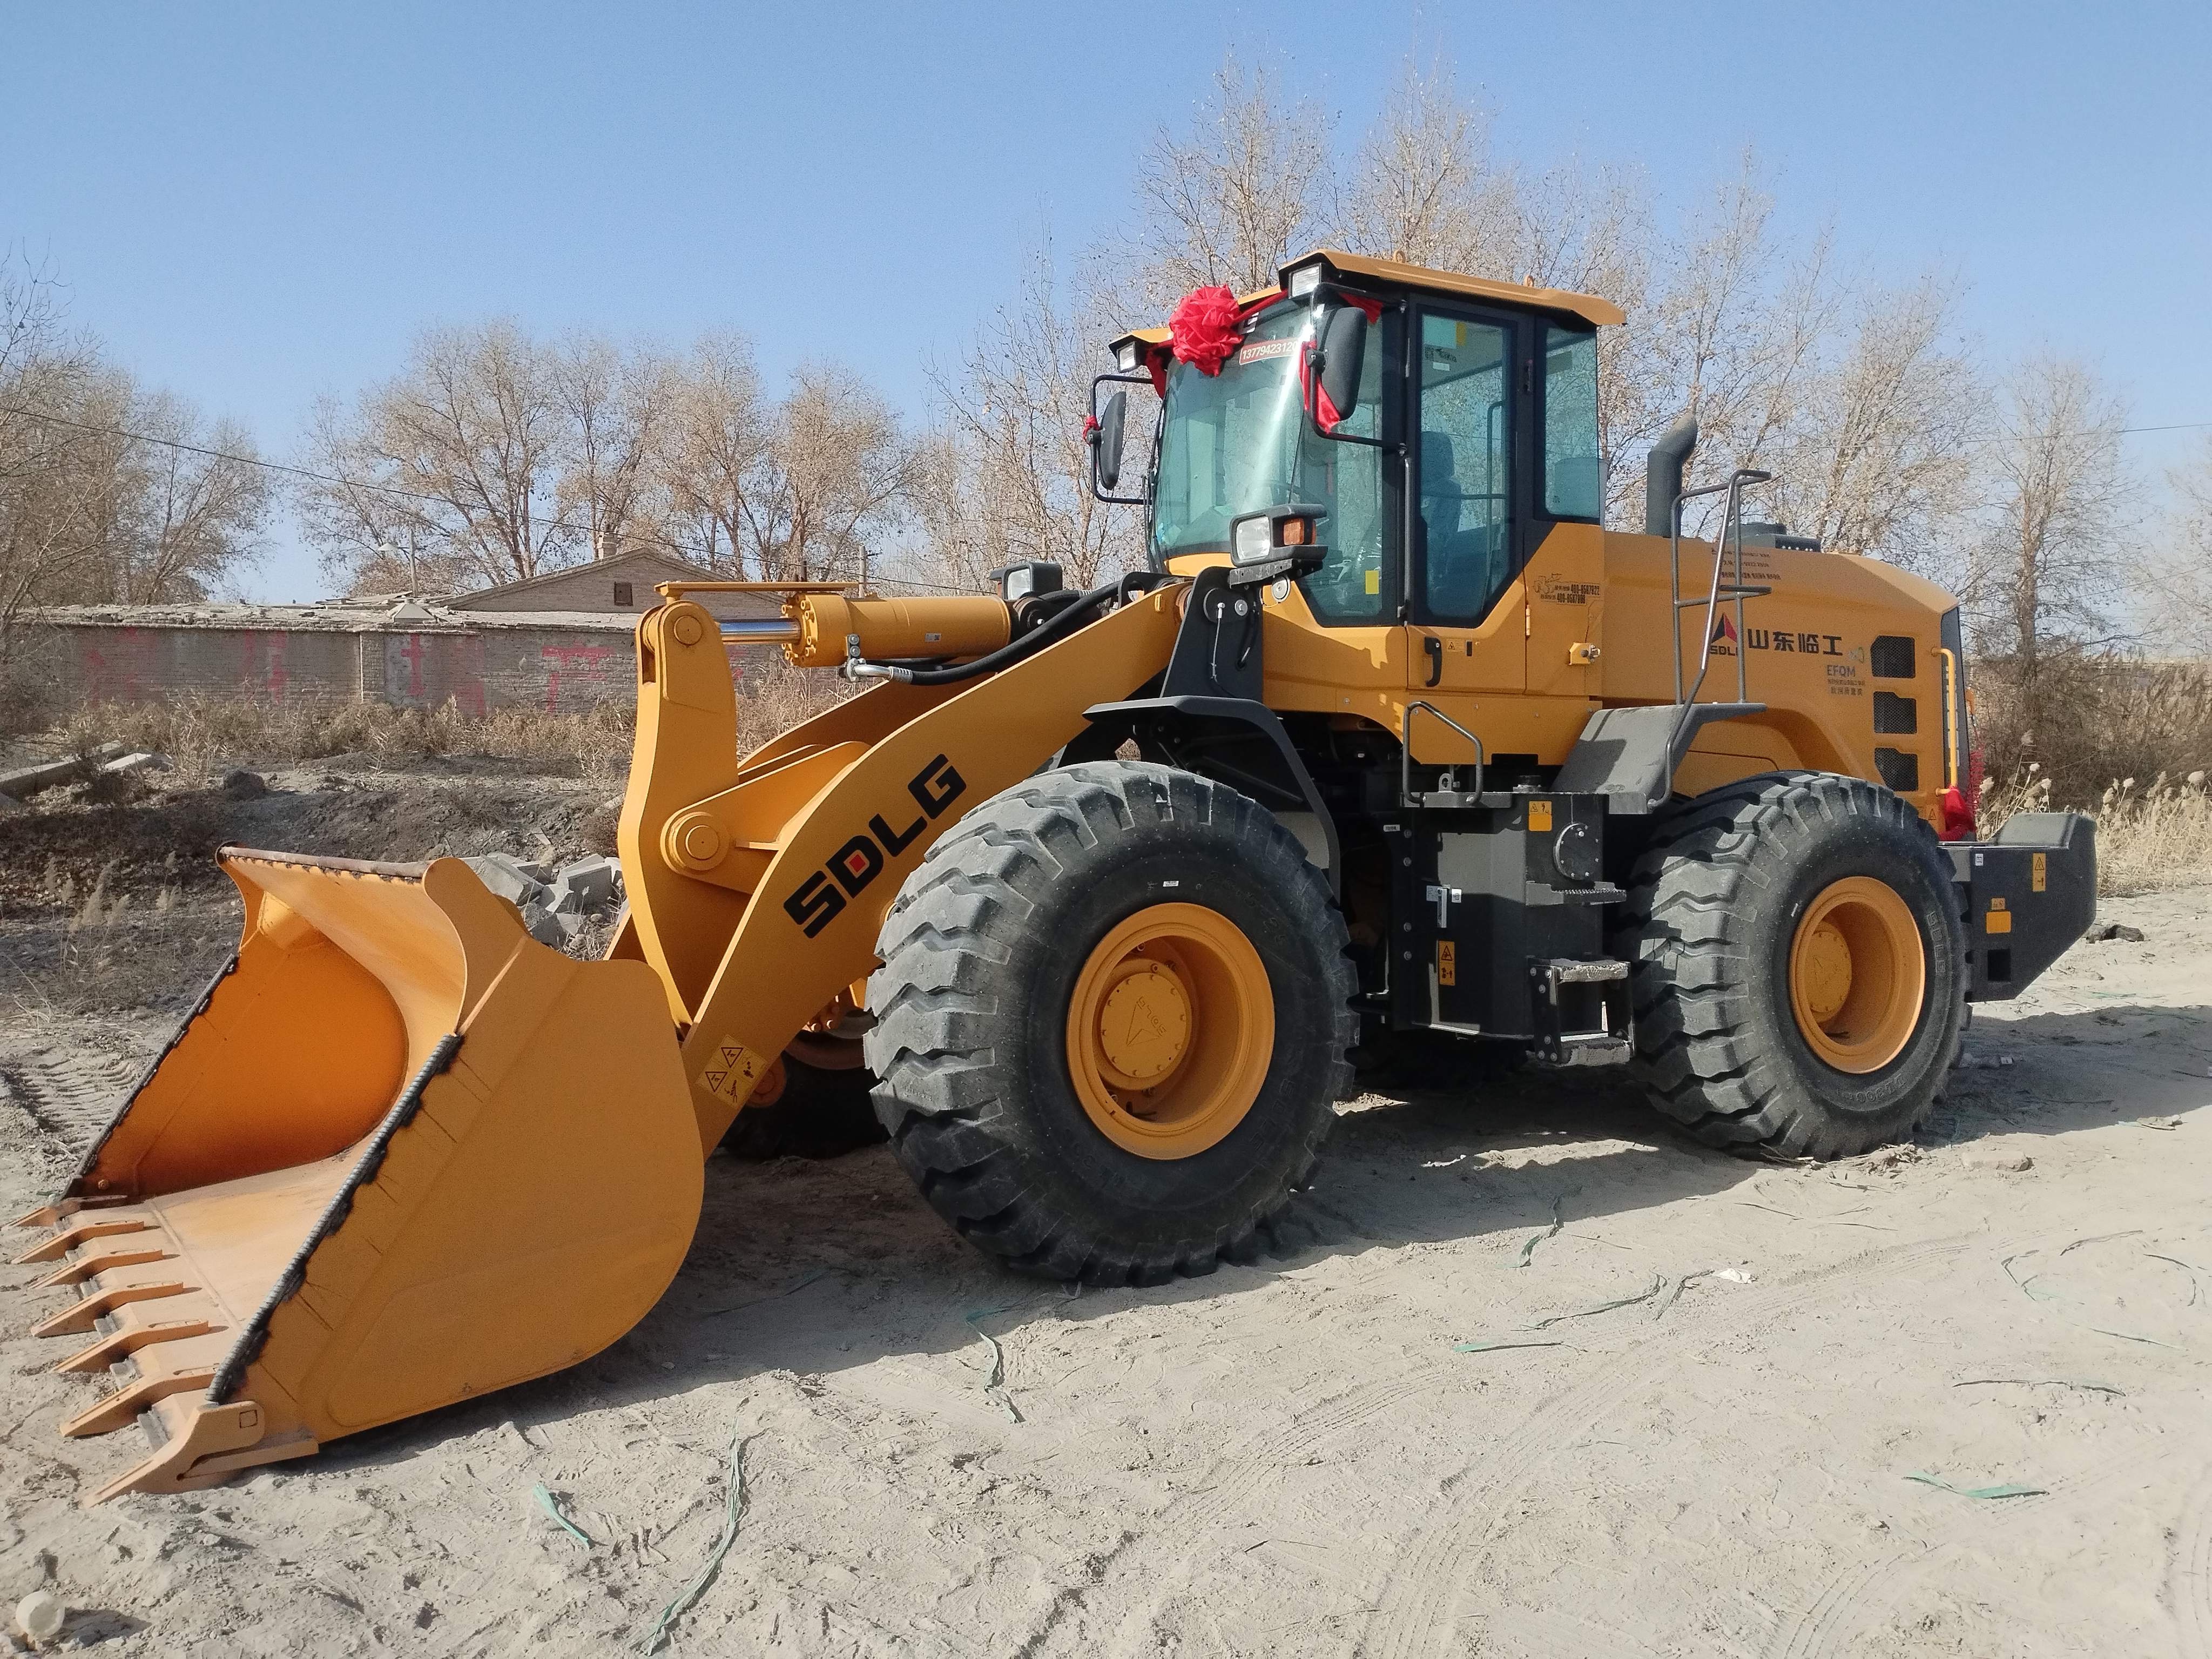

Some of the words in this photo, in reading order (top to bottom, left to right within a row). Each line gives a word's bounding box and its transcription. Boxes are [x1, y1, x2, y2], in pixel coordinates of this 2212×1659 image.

[1710, 645, 1738, 656] SDL
[1747, 628, 1843, 656] 山东临工
[1826, 665, 1856, 677] EFQM
[783, 753, 967, 939] SDLG
[1136, 996, 1167, 1037] SDLG
